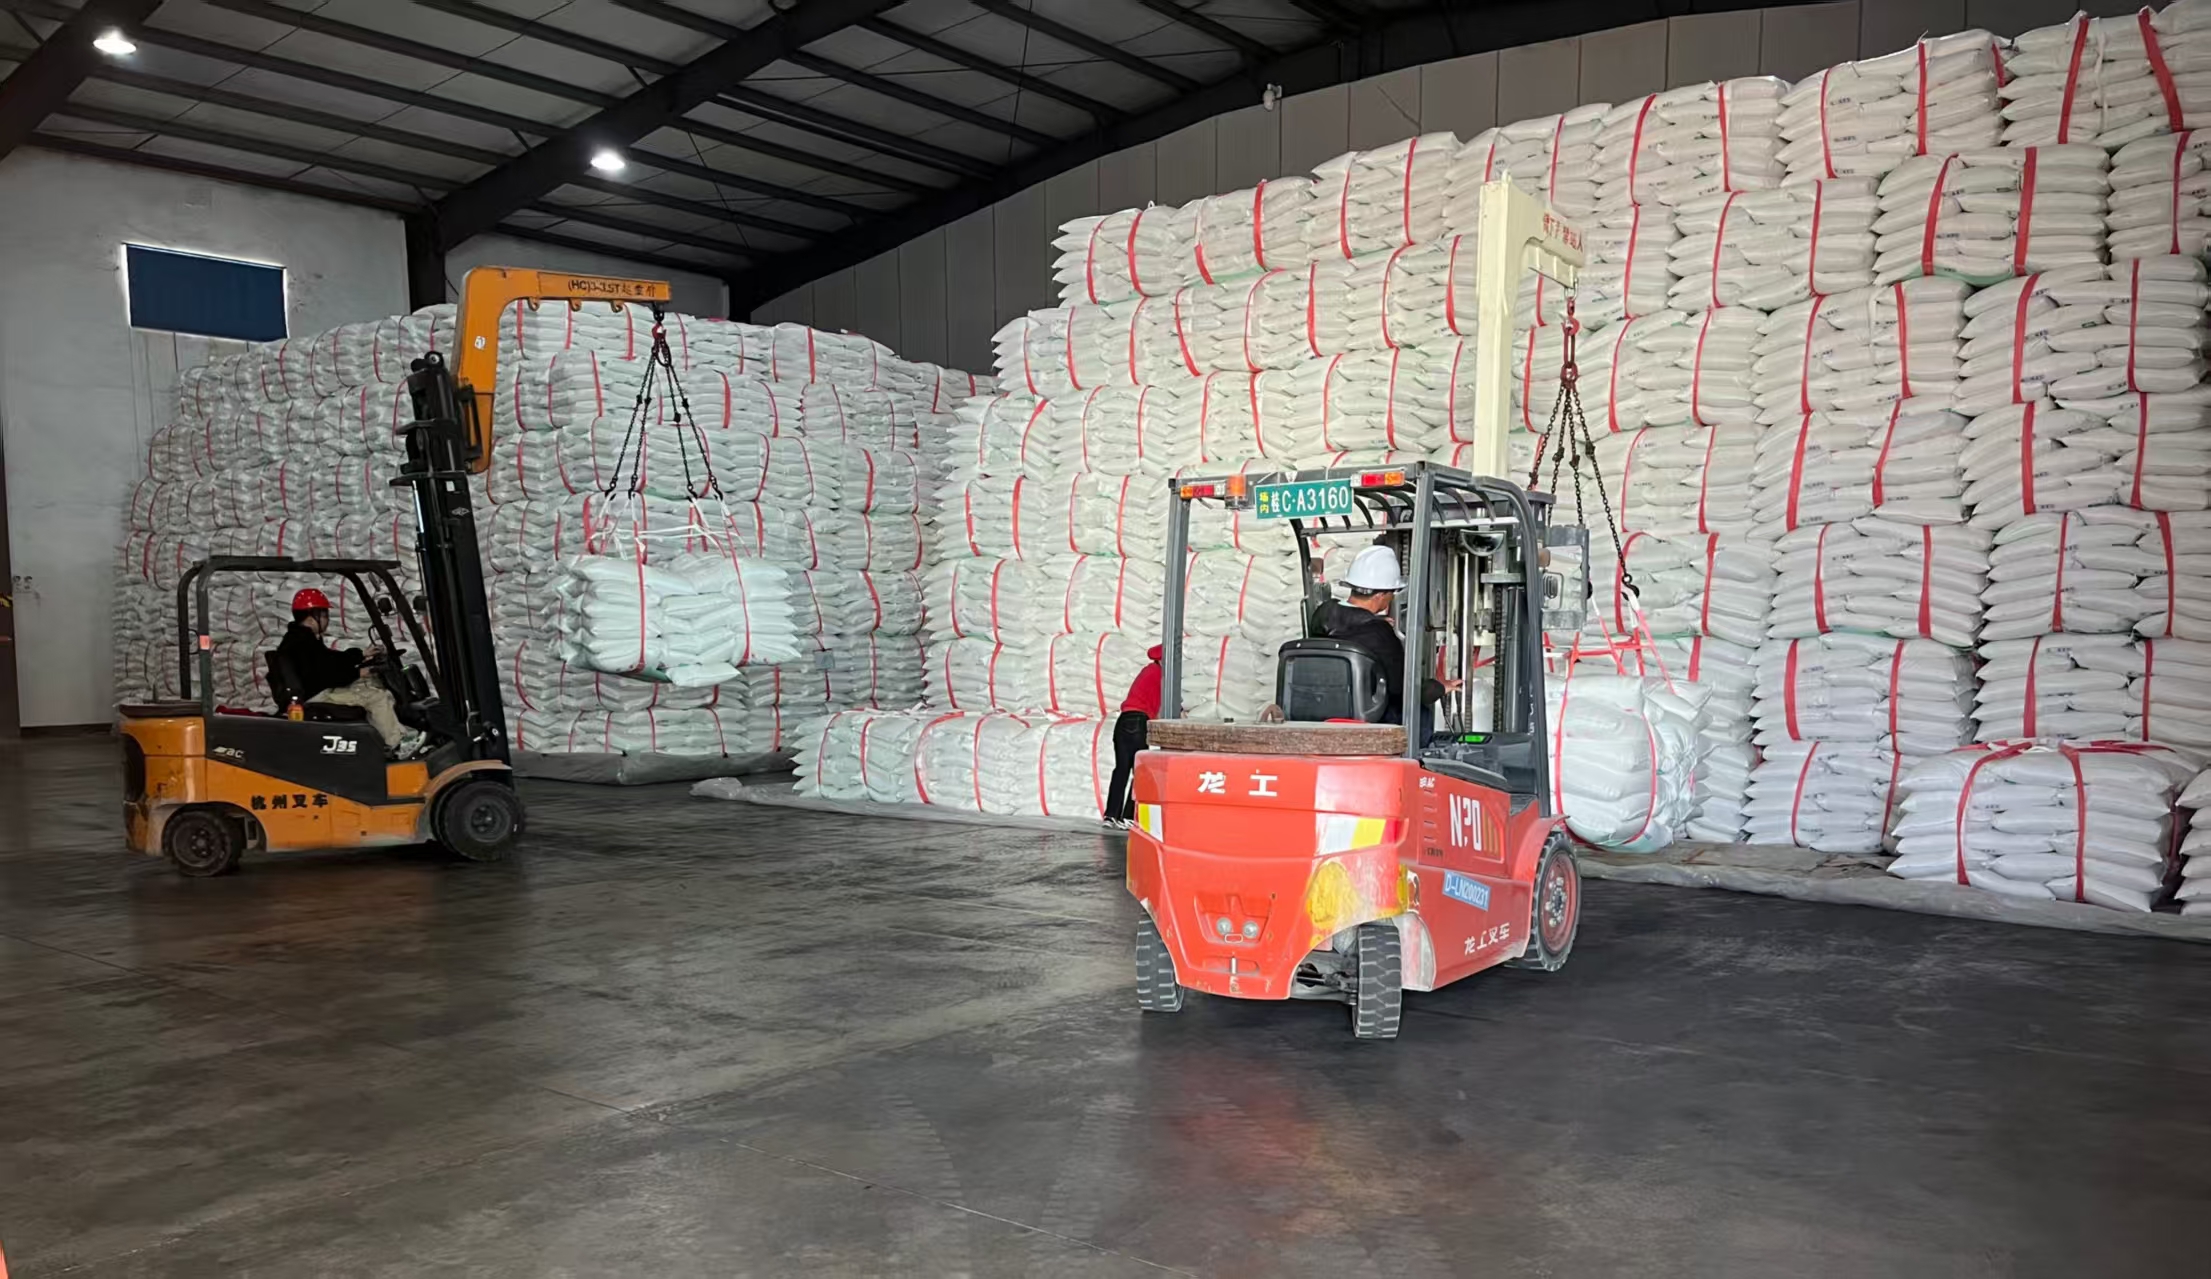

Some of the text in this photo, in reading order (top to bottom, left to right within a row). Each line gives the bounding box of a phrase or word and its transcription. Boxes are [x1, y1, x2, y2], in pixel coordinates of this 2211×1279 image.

[1197, 769, 1278, 797] 龙工
[252, 793, 328, 810] 杭州叉车
[1465, 922, 1510, 956] 龙工叉车
